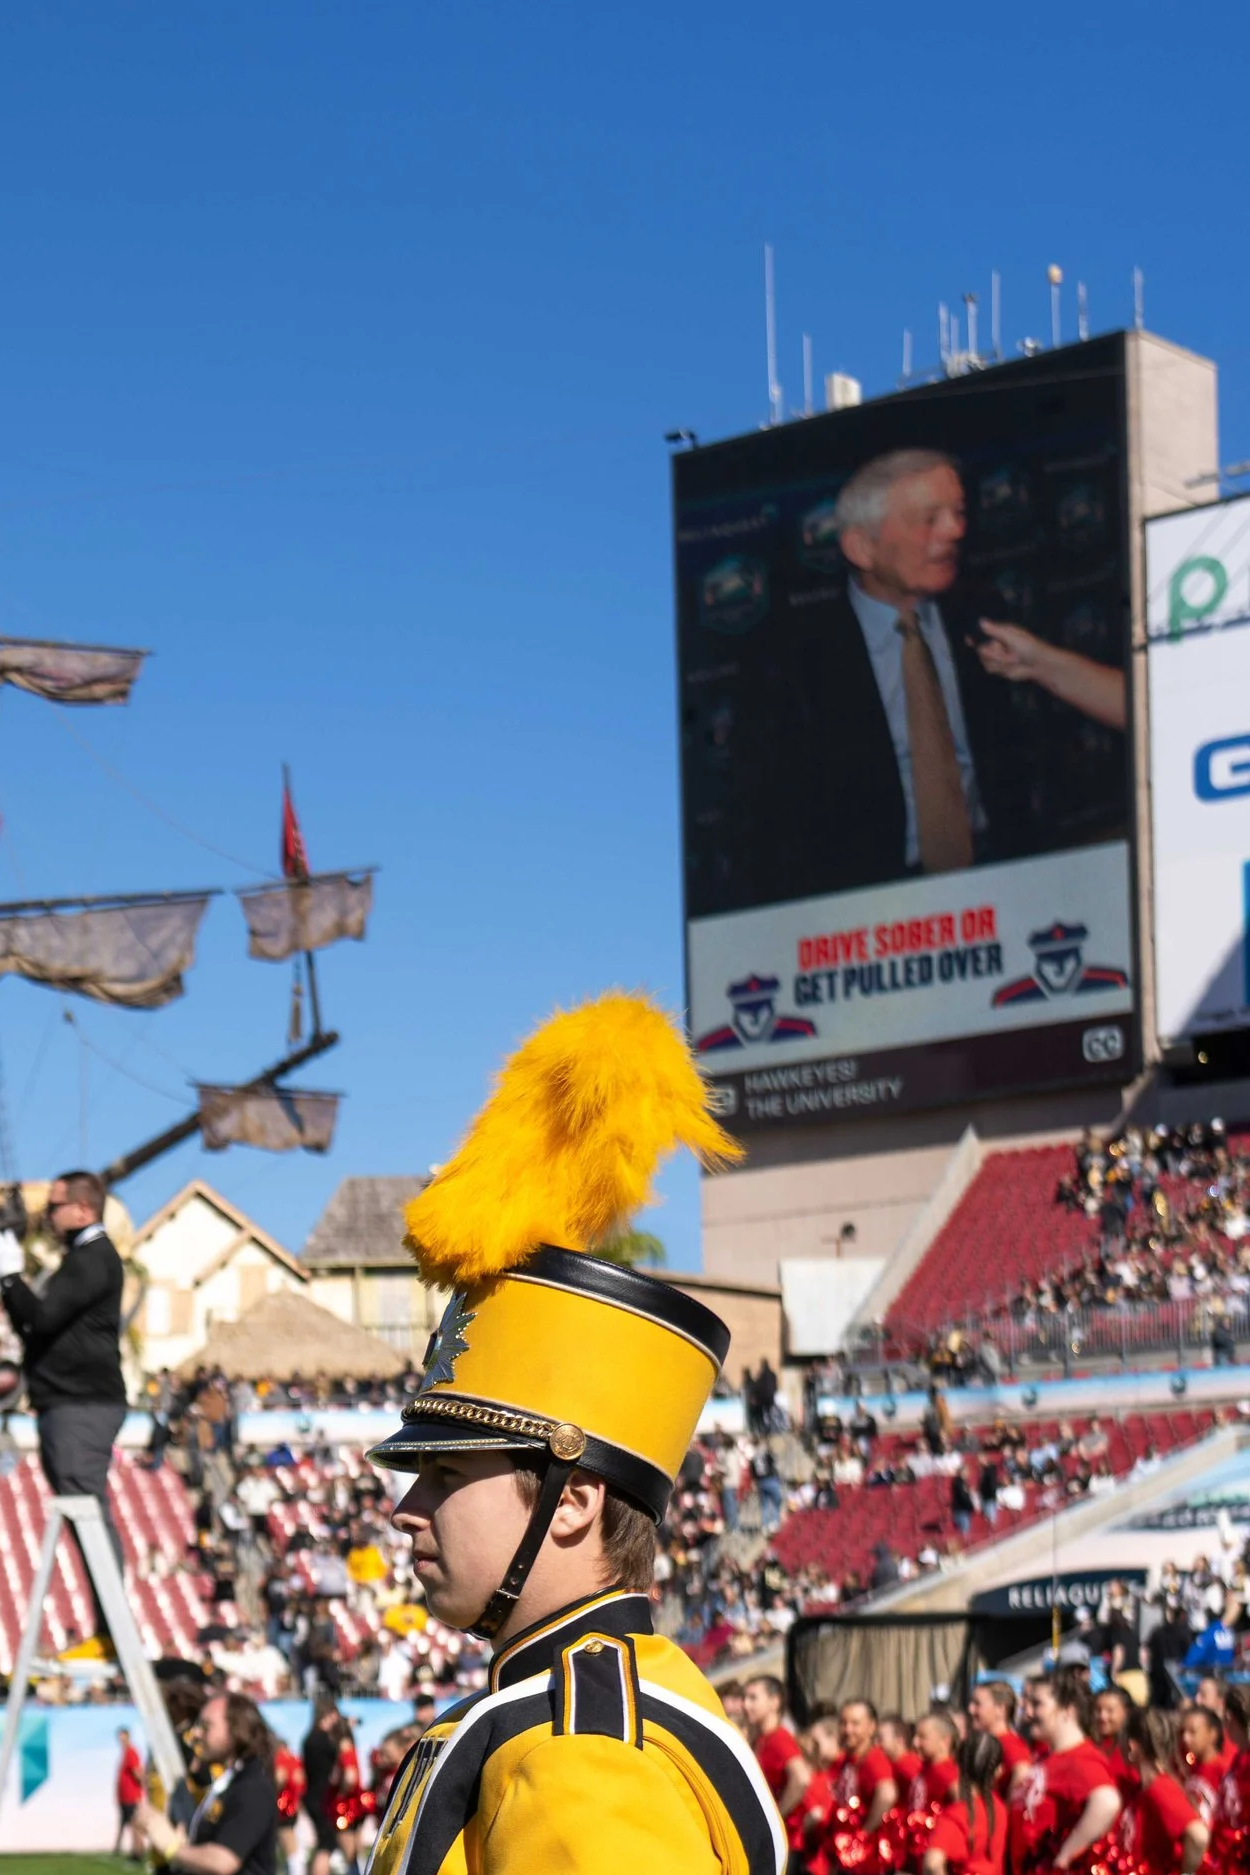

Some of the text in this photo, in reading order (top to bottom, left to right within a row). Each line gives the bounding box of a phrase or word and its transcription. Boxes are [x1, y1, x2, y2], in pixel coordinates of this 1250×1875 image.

[797, 904, 997, 972] DRIVE SOBER OR
[794, 942, 1004, 1007] GET PULLED OVER
[745, 1076, 903, 1120] THE UNIVERSITY
[1008, 1578, 1138, 1610] RELIAQU
